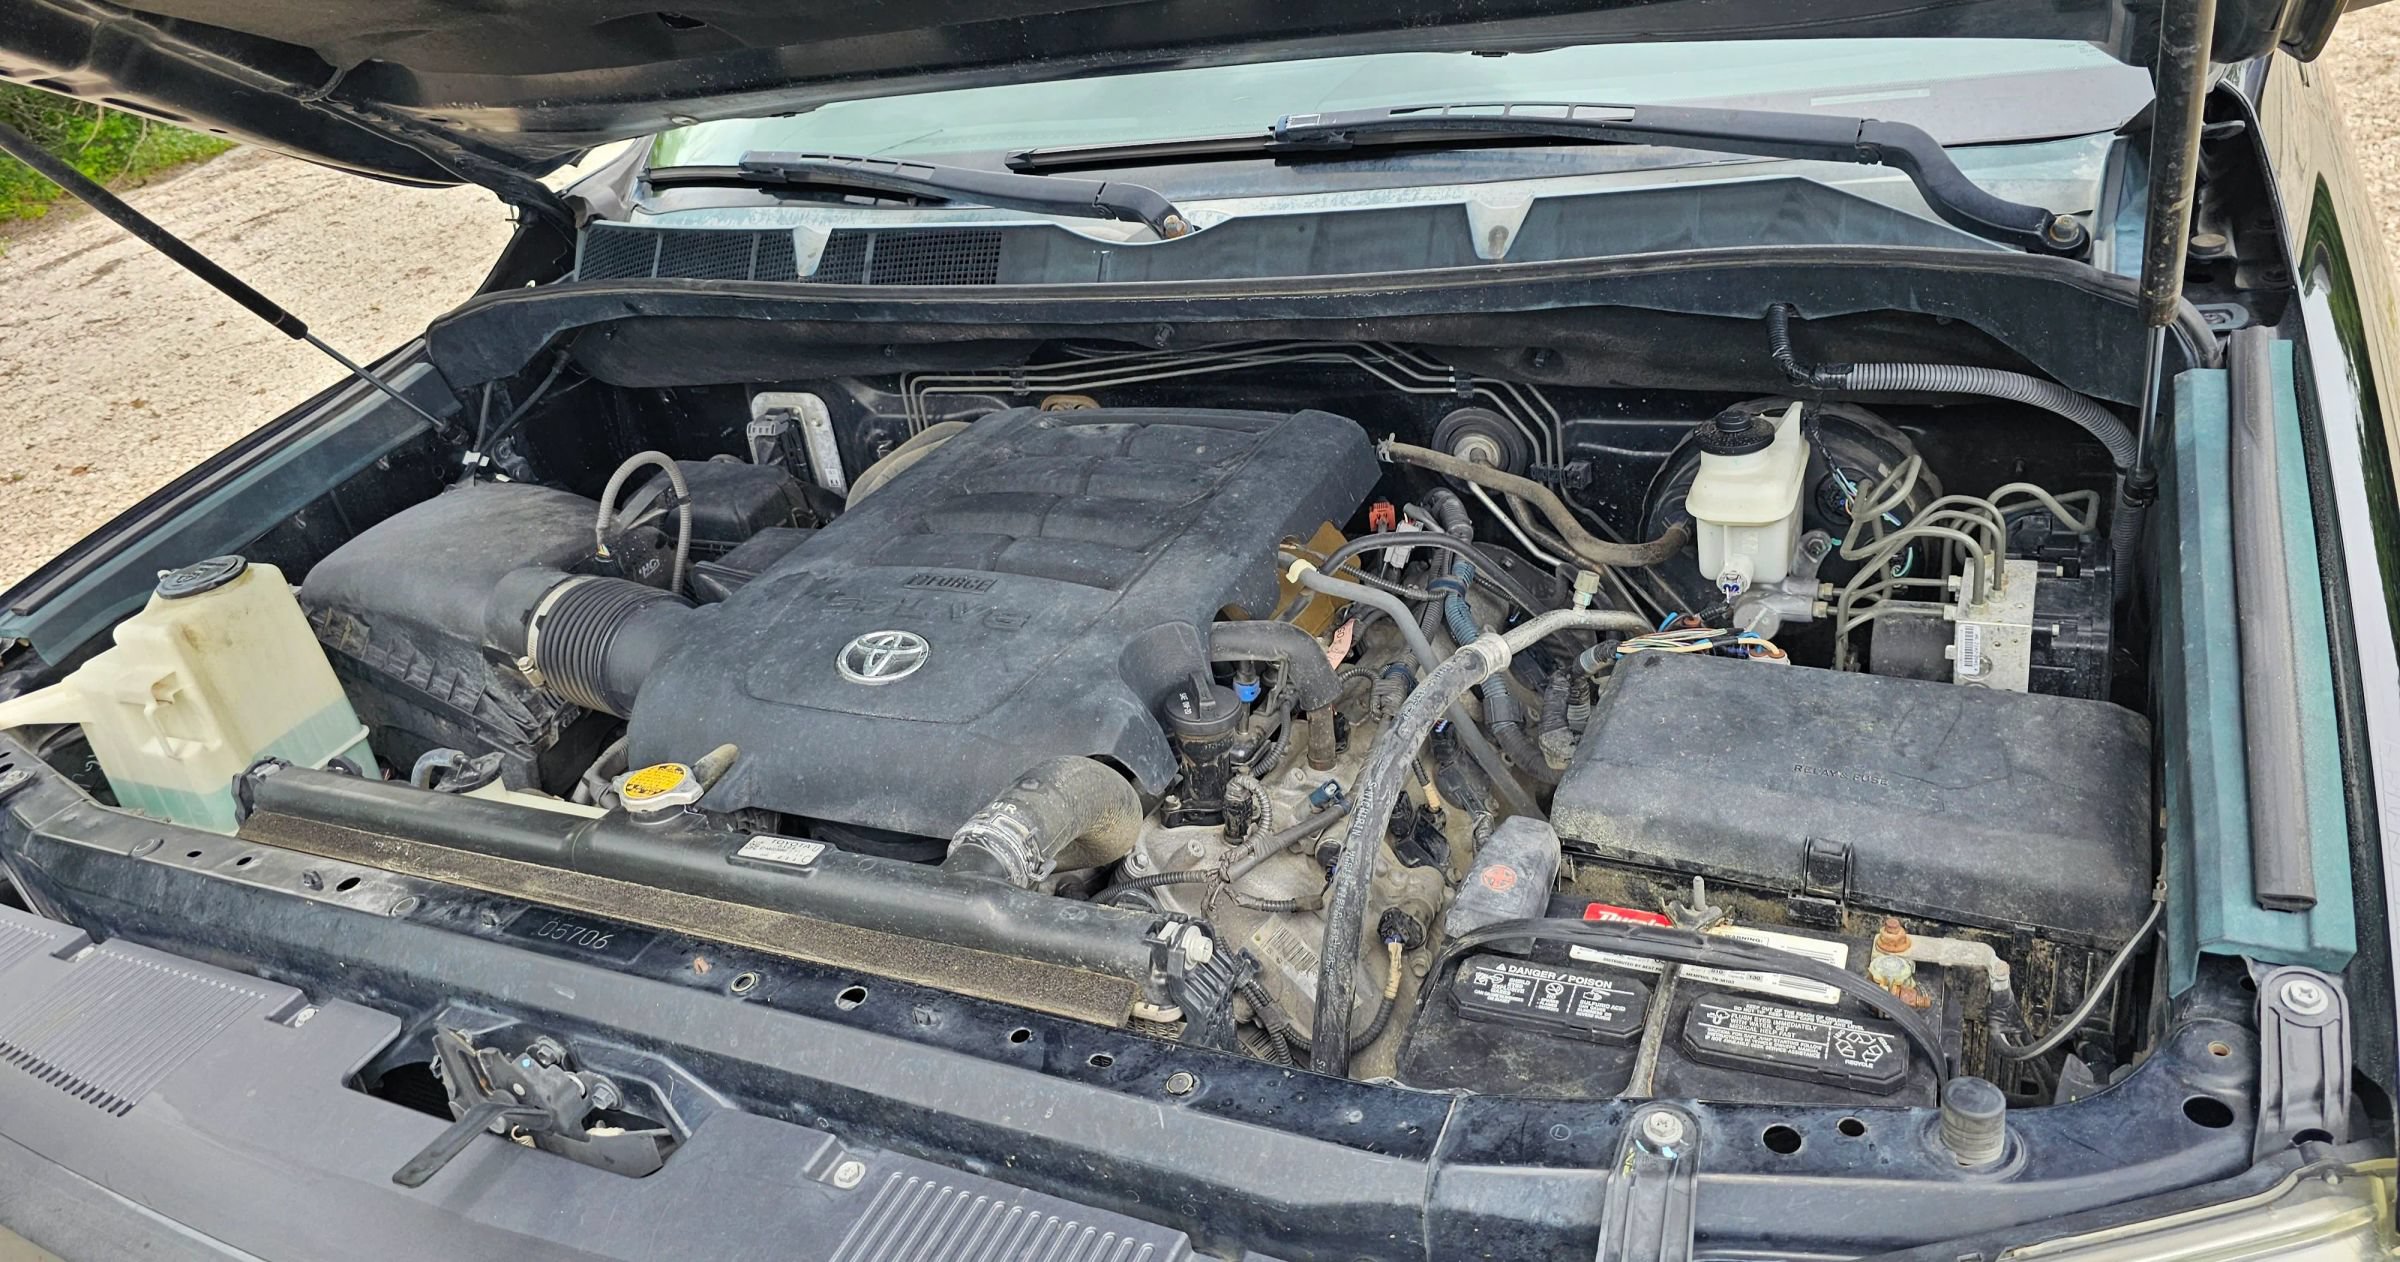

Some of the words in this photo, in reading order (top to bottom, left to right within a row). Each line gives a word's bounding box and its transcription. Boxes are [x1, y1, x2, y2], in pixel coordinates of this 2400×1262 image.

[1793, 764, 1838, 778] RELAY
[1852, 773, 1889, 786] FUSE
[537, 920, 615, 949] 05706
[1508, 963, 1557, 980] DANGER
[1568, 975, 1613, 990] POISON
[1729, 1022, 1758, 1032] MEDICAL
[1760, 1027, 1778, 1035] HELP
[1779, 1031, 1796, 1039] FAST
[1730, 1018, 1749, 1026] WITH
[1775, 1024, 1789, 1032] GET
[1731, 1012, 1753, 1022] FLUSH
[1753, 1016, 1772, 1024] EYES
[1773, 1019, 1818, 1032] IMMEDIATELY
